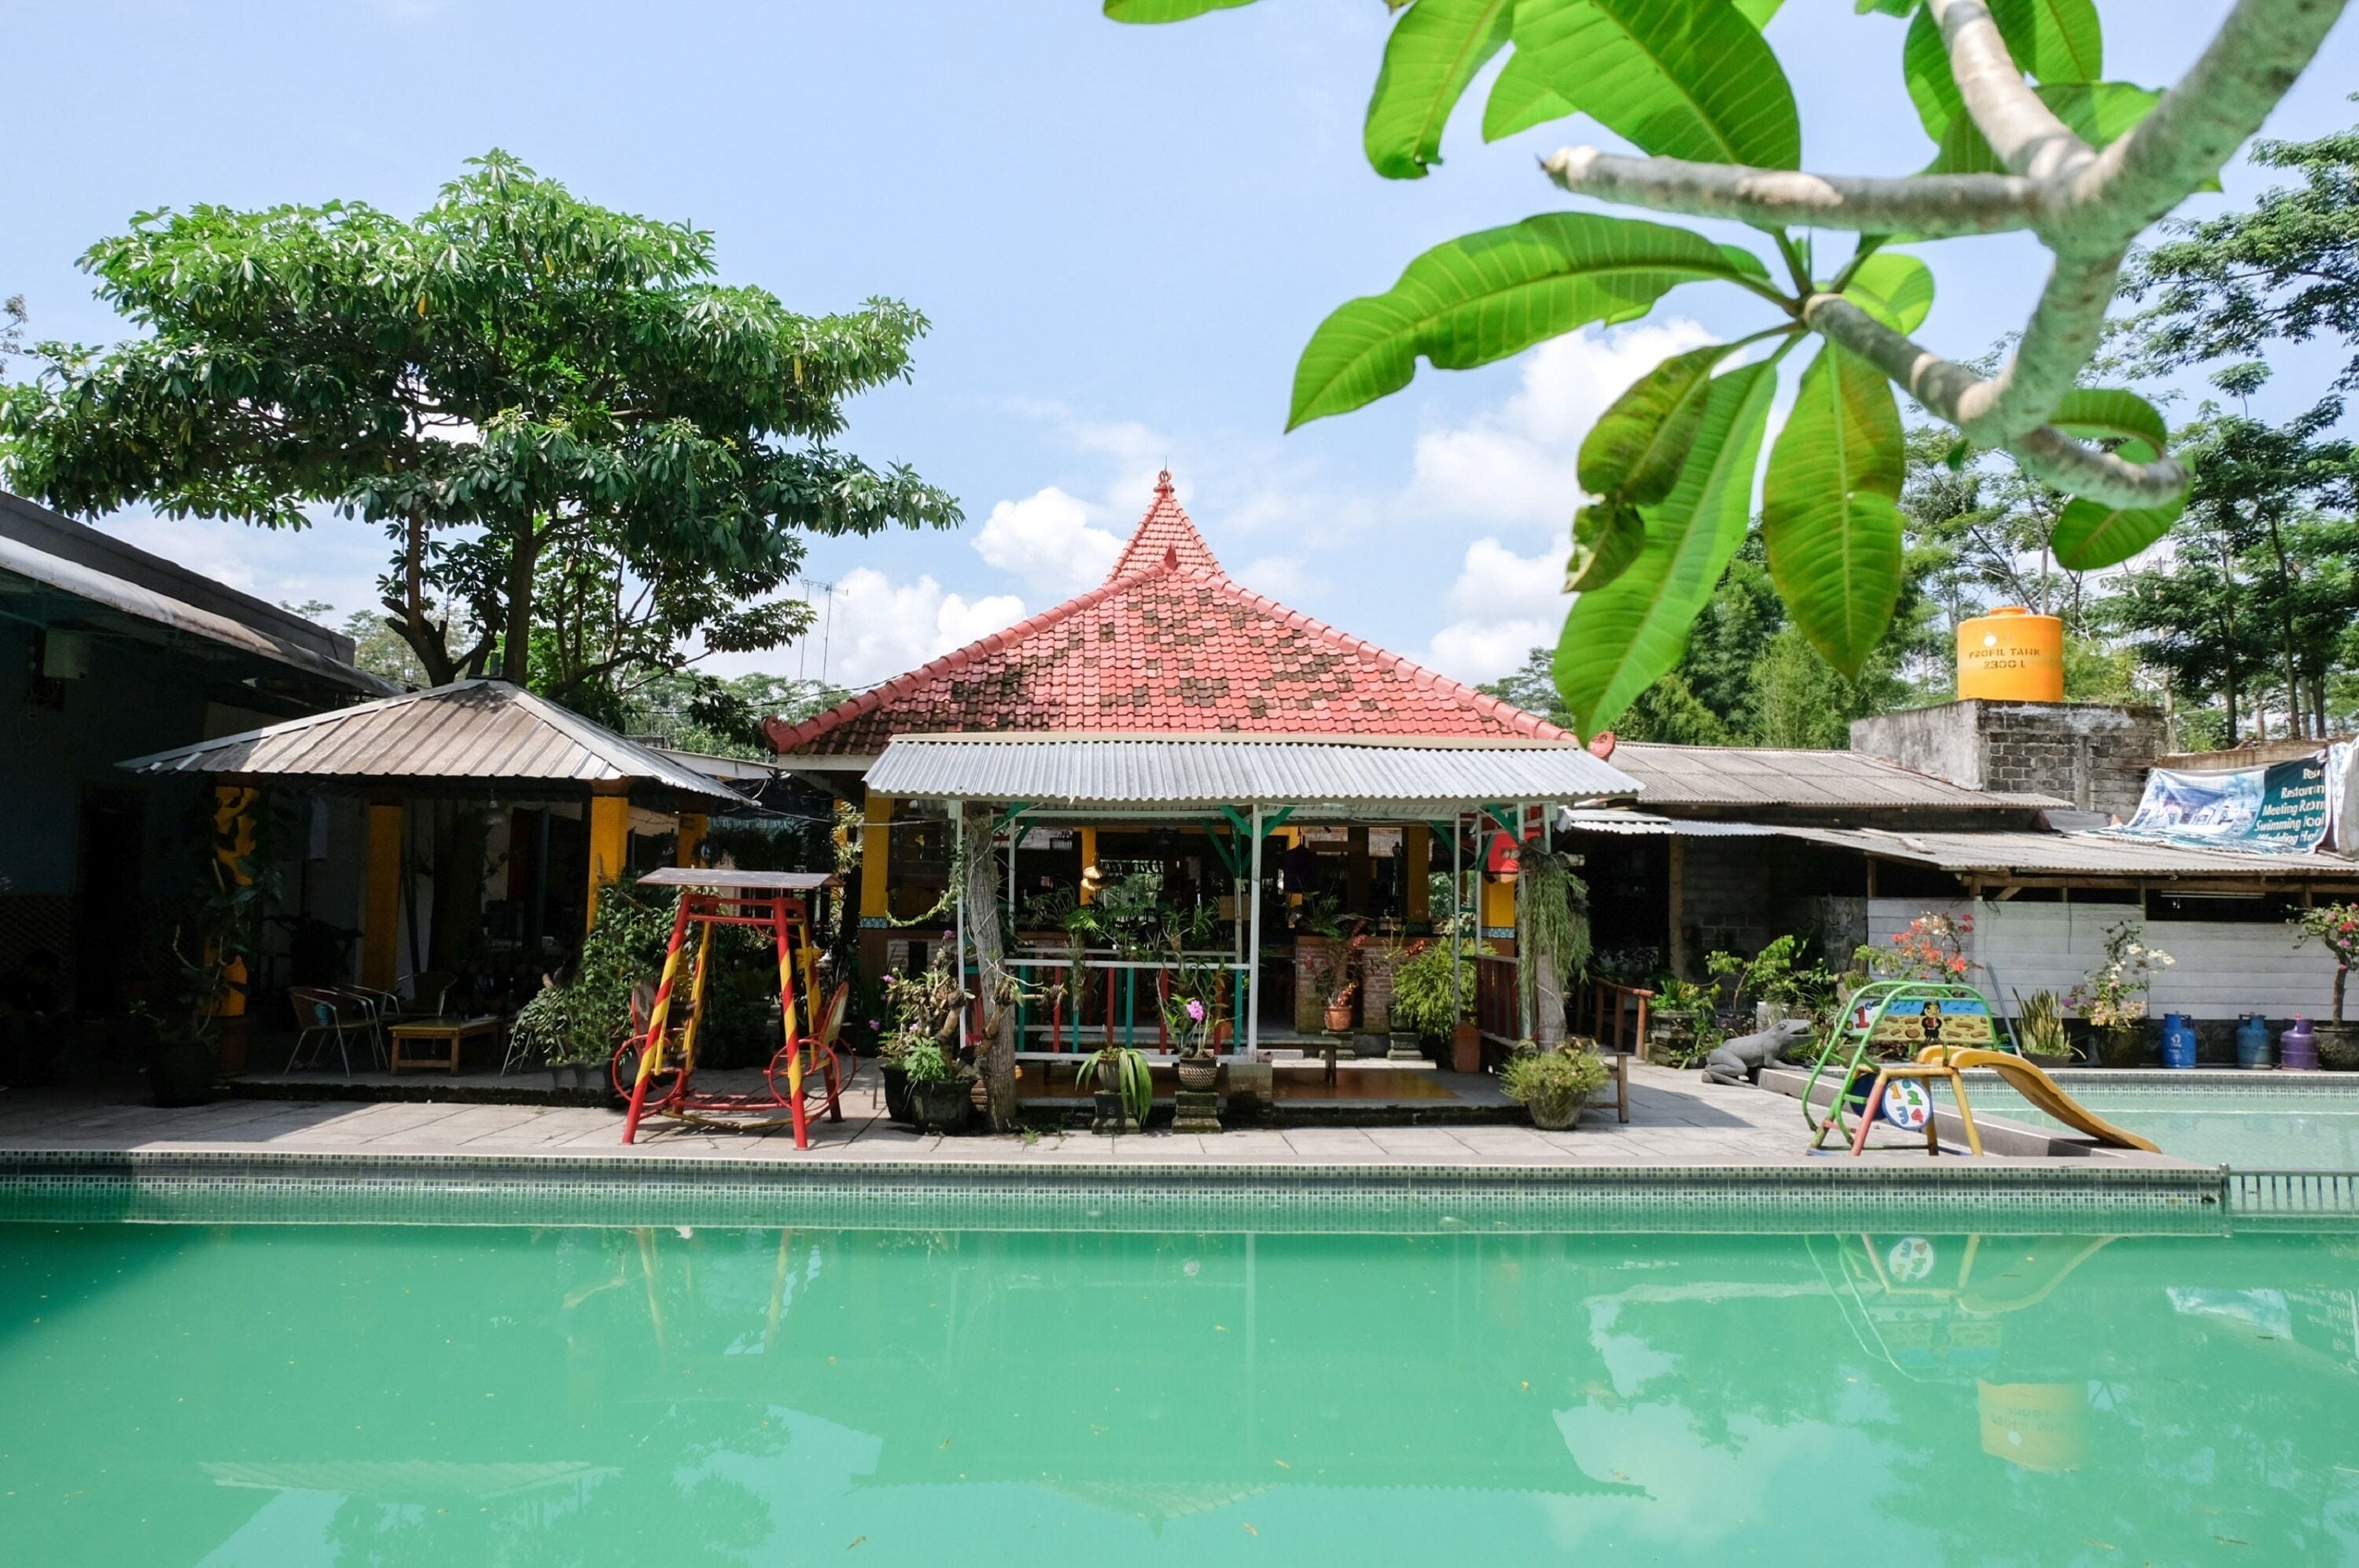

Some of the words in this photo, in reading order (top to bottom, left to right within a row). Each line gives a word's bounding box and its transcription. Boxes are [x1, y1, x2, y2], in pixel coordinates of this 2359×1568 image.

[1969, 648, 2005, 659] PROFIL
[2010, 647, 2041, 656] TANK
[1984, 660, 2017, 669] 2300
[2261, 802, 2298, 816] Meeting
[2254, 817, 2301, 831] Swimming
[1854, 1006, 1870, 1029] 1
[1889, 1083, 1901, 1099] 1
[1907, 1090, 1923, 1106] 2
[1896, 1106, 1909, 1124] 3
[1912, 1108, 1923, 1124] 4
